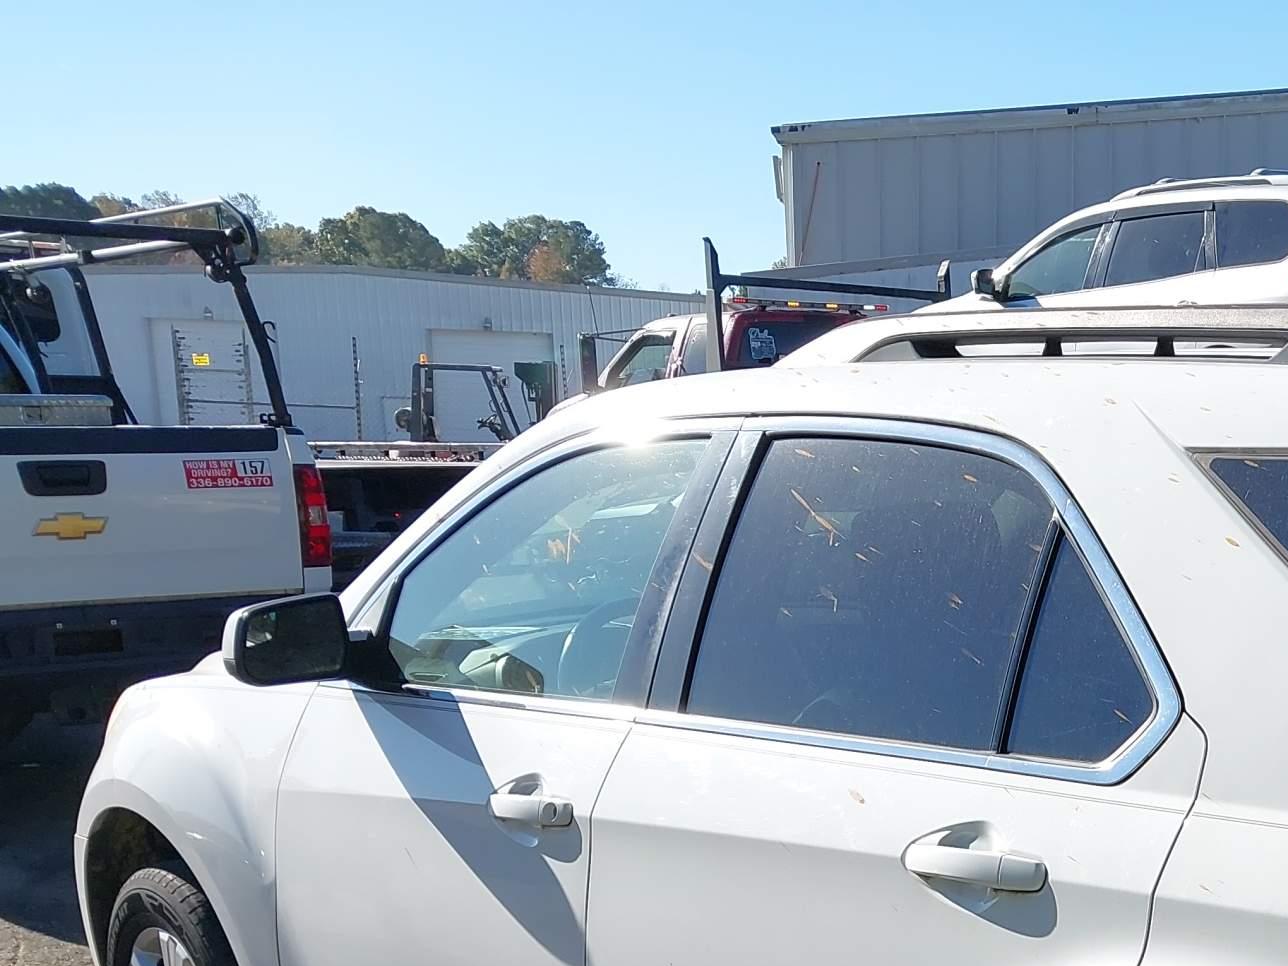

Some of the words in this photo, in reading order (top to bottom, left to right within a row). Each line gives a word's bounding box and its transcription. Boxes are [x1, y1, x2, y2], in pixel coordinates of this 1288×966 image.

[186, 460, 207, 469] HOW
[208, 460, 218, 469] IS
[219, 460, 234, 468] MY
[240, 460, 265, 475] 157
[191, 468, 232, 478] DRIVING?
[189, 477, 271, 488] 336-890-6170
